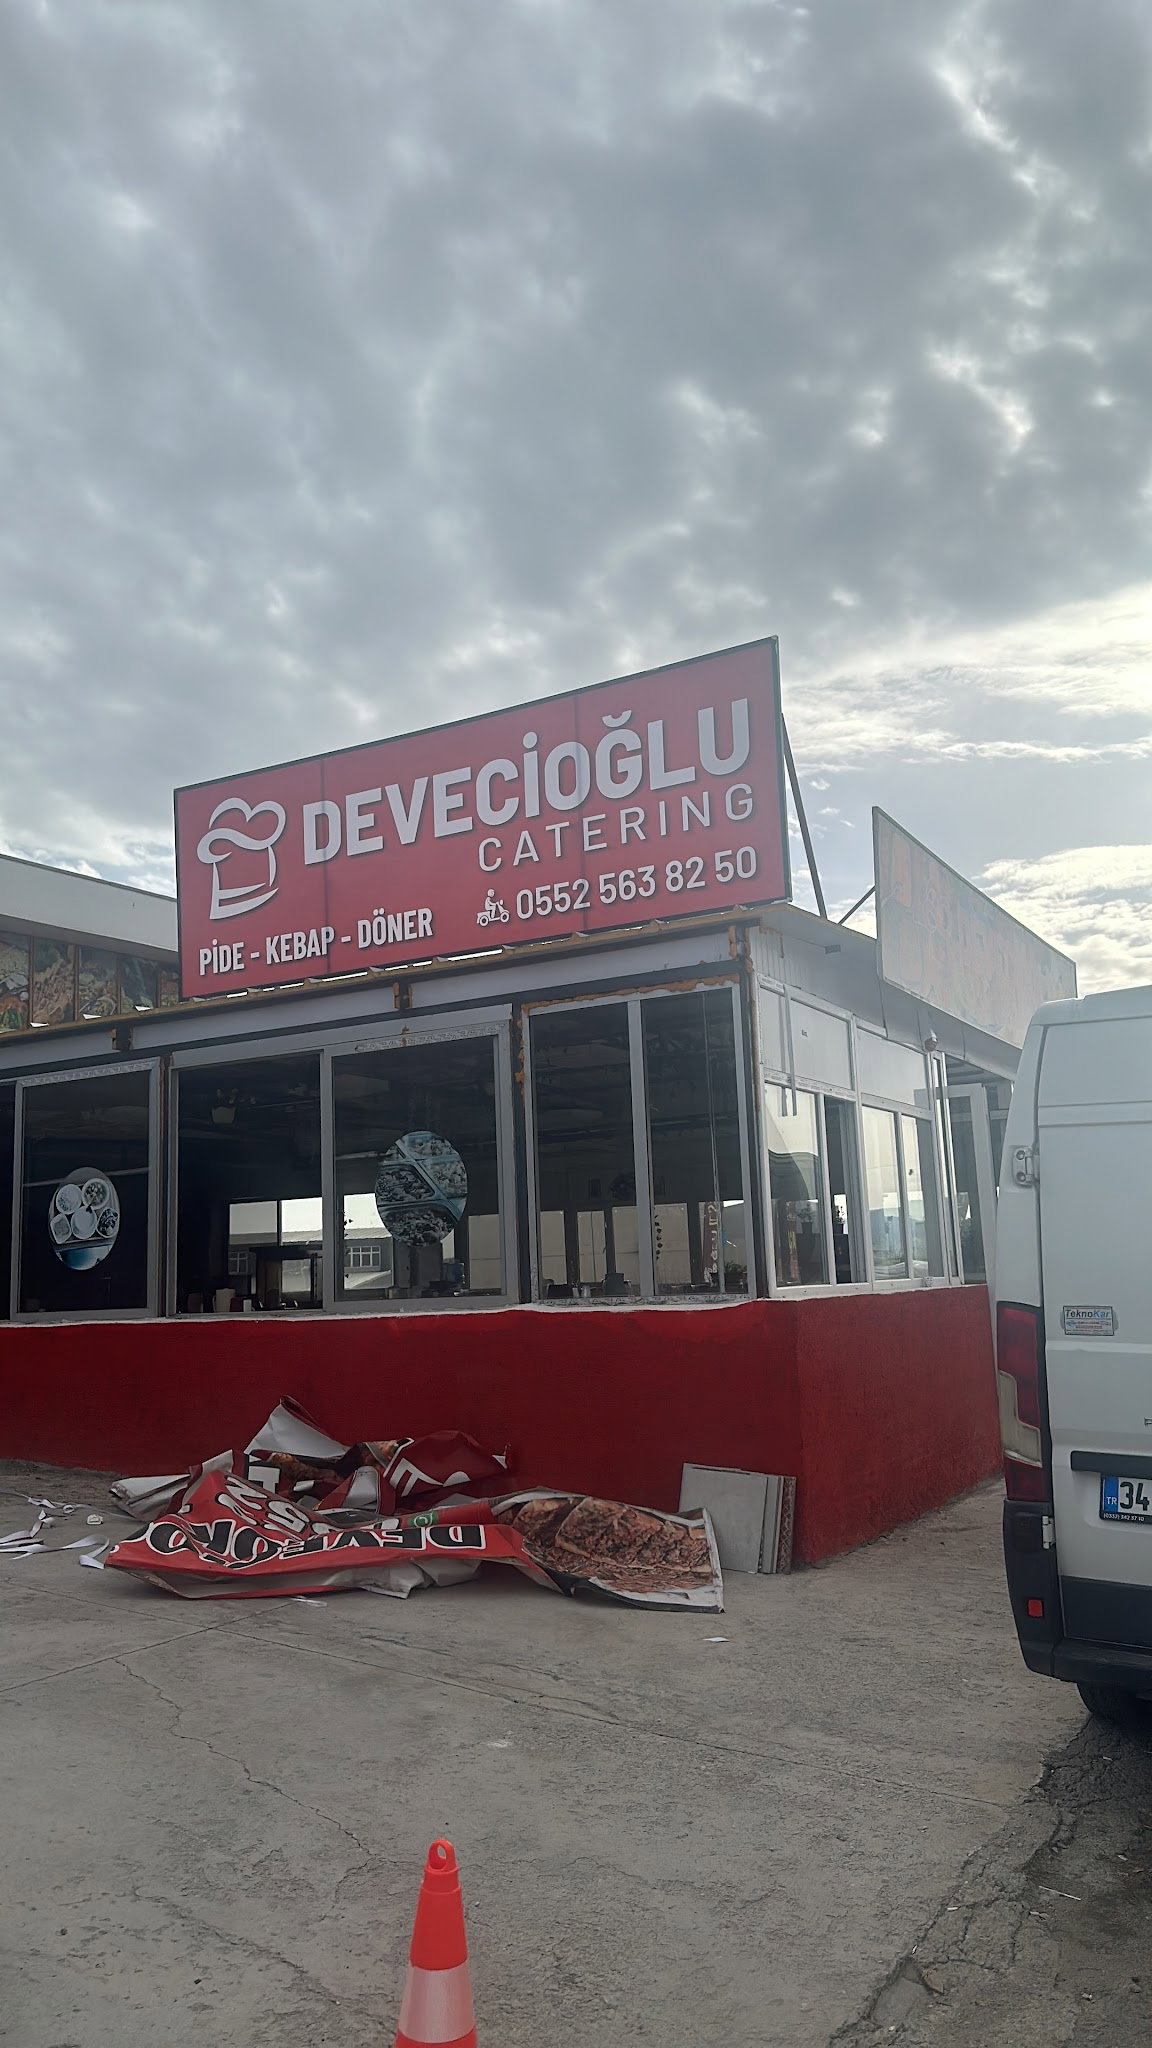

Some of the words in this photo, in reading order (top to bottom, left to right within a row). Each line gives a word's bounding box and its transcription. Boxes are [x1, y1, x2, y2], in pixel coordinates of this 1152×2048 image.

[302, 698, 751, 865] DEVECİOĞLU
[478, 783, 755, 872] CATERING
[516, 878, 591, 920] 0552
[599, 864, 656, 904] 563
[665, 856, 706, 892] 82
[714, 846, 757, 883] 50
[199, 938, 244, 976] PİDE
[265, 926, 335, 965] KEBAP
[357, 908, 433, 949] DÖNER
[1065, 1309, 1110, 1318] TeknoKar
[1106, 1496, 1118, 1505] TR
[1119, 1481, 1150, 1511] 34
